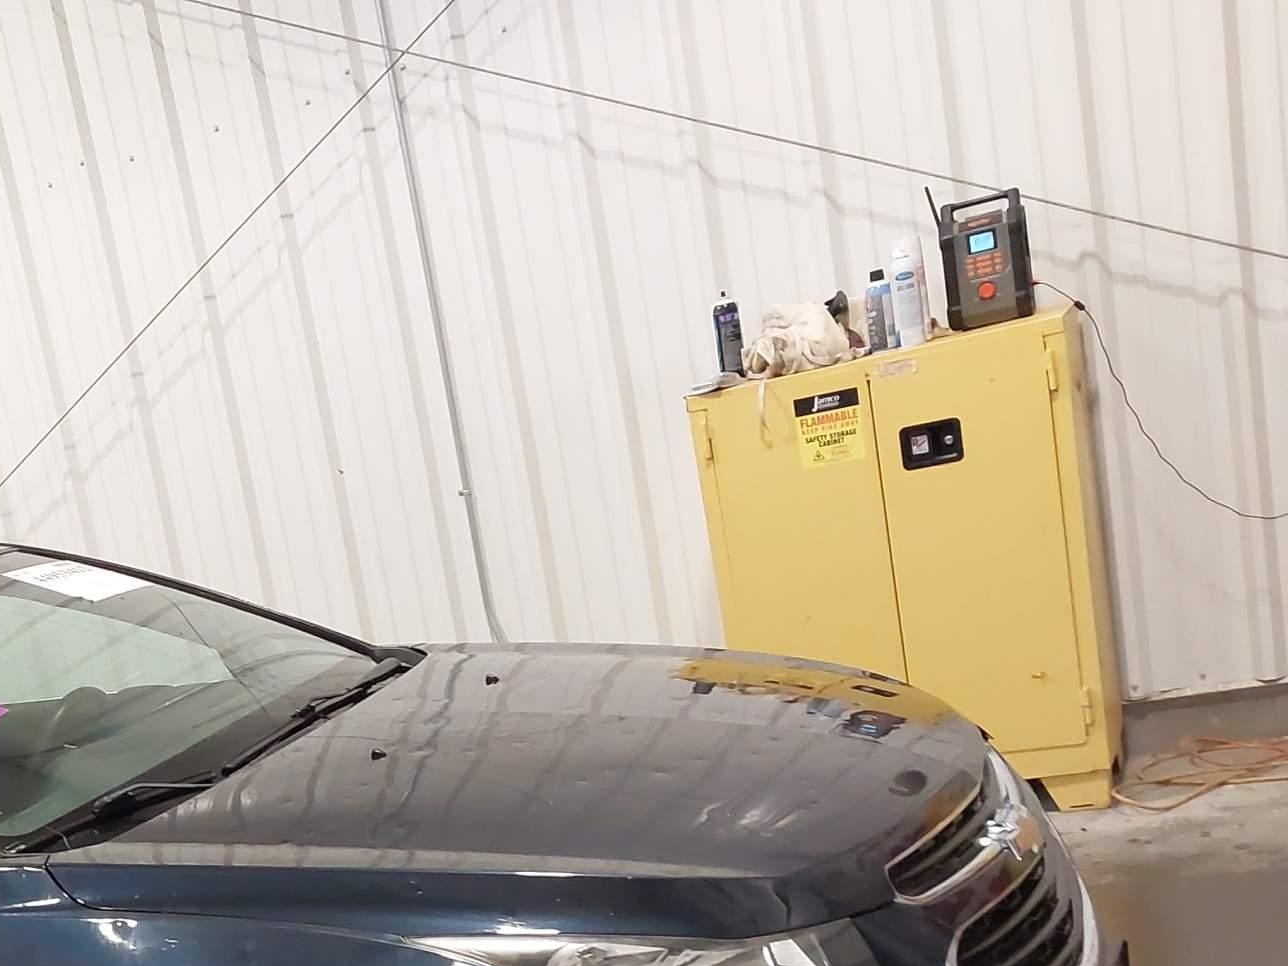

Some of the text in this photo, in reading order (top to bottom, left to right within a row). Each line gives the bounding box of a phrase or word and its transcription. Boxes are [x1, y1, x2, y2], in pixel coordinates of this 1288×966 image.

[800, 409, 858, 430] FLAMMABLE
[805, 428, 857, 444] SAFETY STORAGE
[819, 437, 844, 447] CABINET
